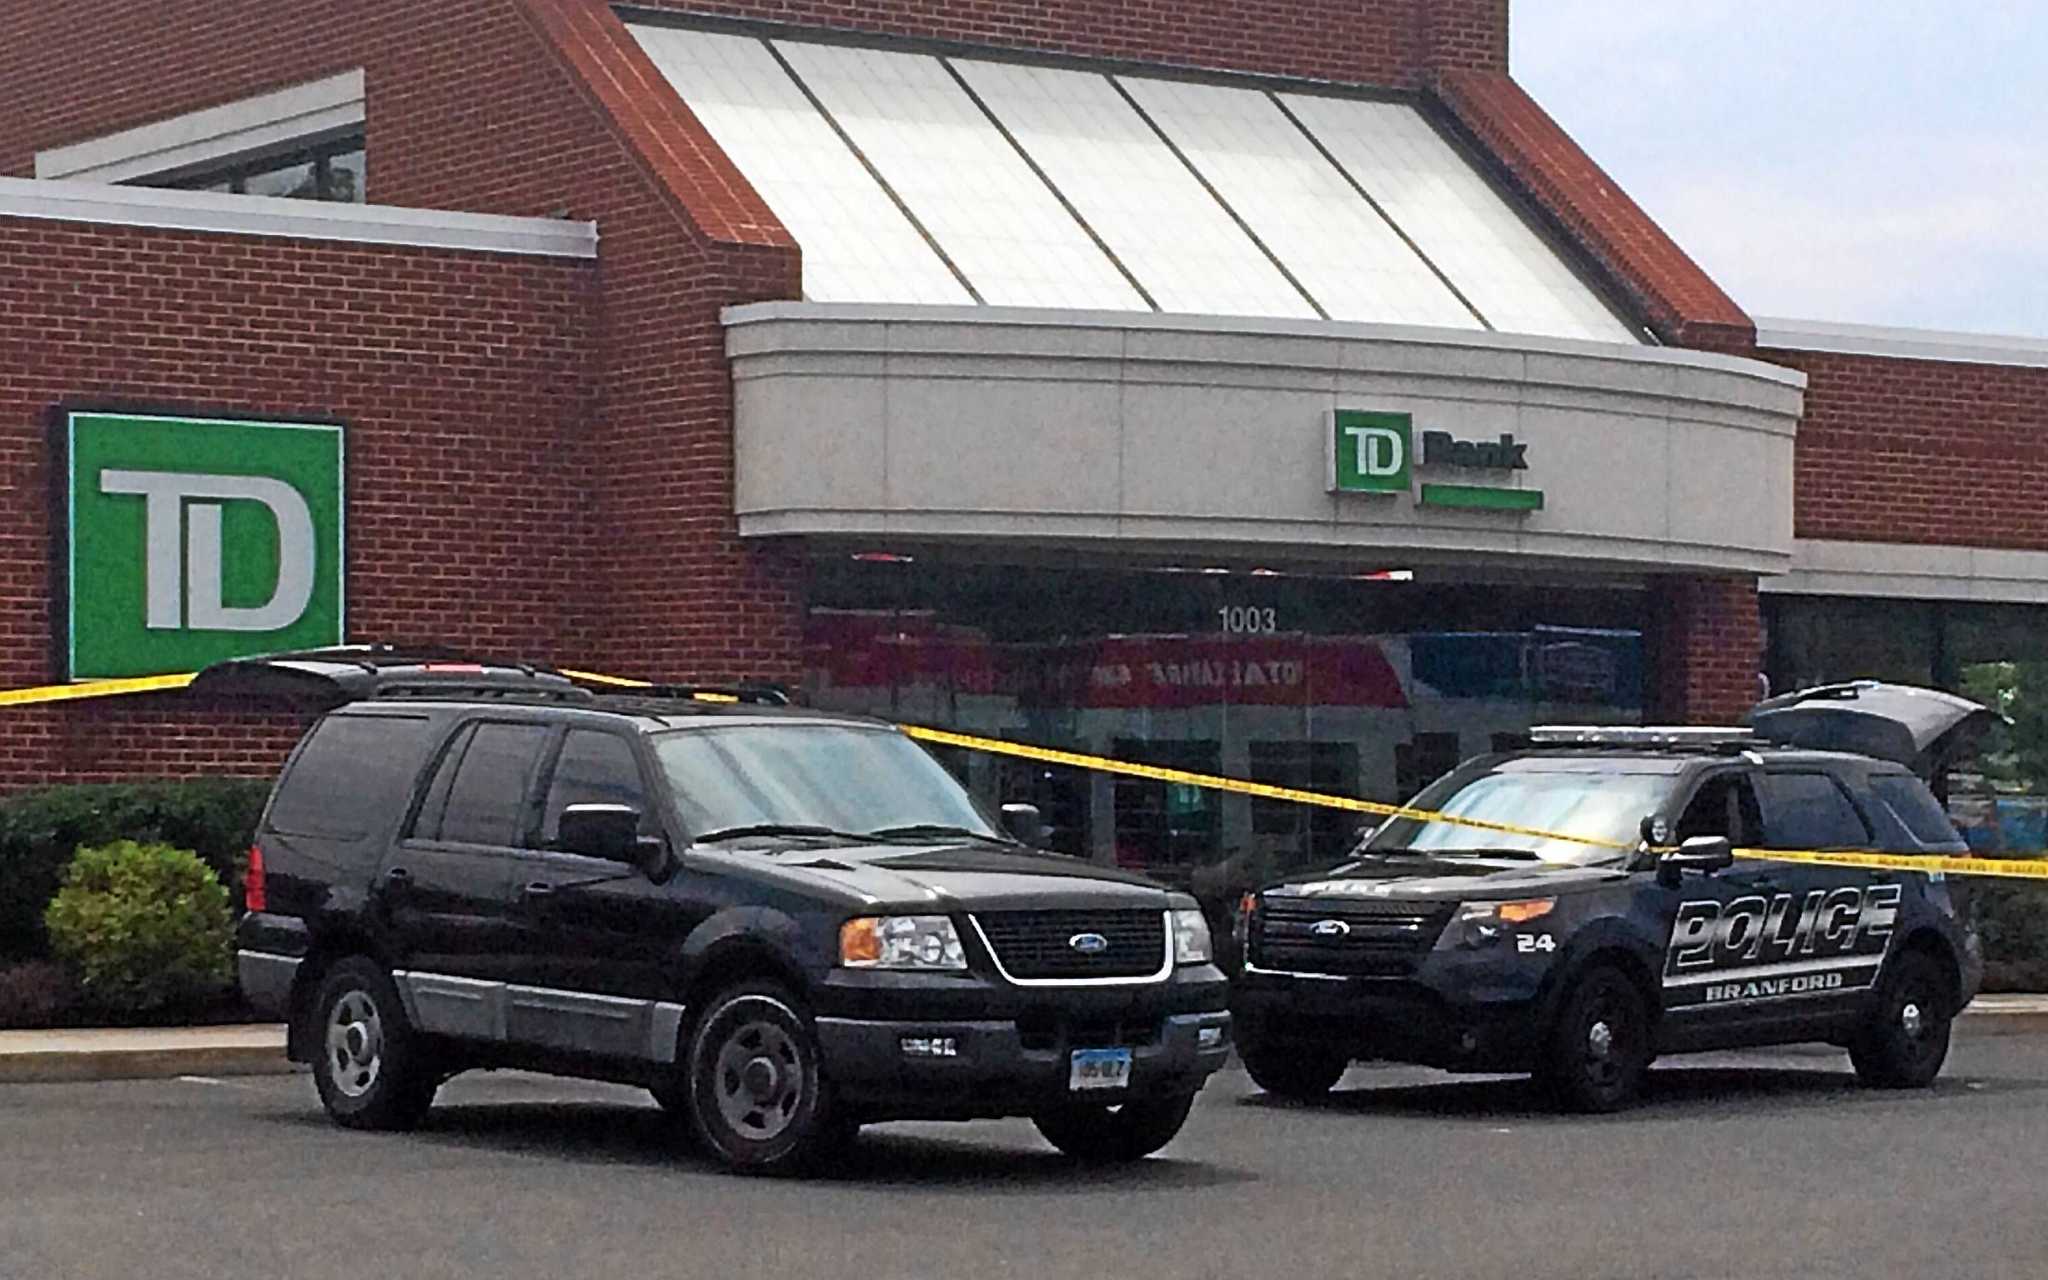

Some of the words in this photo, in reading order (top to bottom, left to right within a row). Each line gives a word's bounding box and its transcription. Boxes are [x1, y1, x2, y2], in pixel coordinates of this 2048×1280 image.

[1345, 426, 1403, 476] TD
[1423, 430, 1529, 470] Bank
[101, 469, 315, 631] TD
[1218, 605, 1276, 633] 1003
[1516, 933, 1556, 953] 24
[1663, 884, 1901, 972] POLICE
[1706, 972, 1842, 1001] BRANFORD
